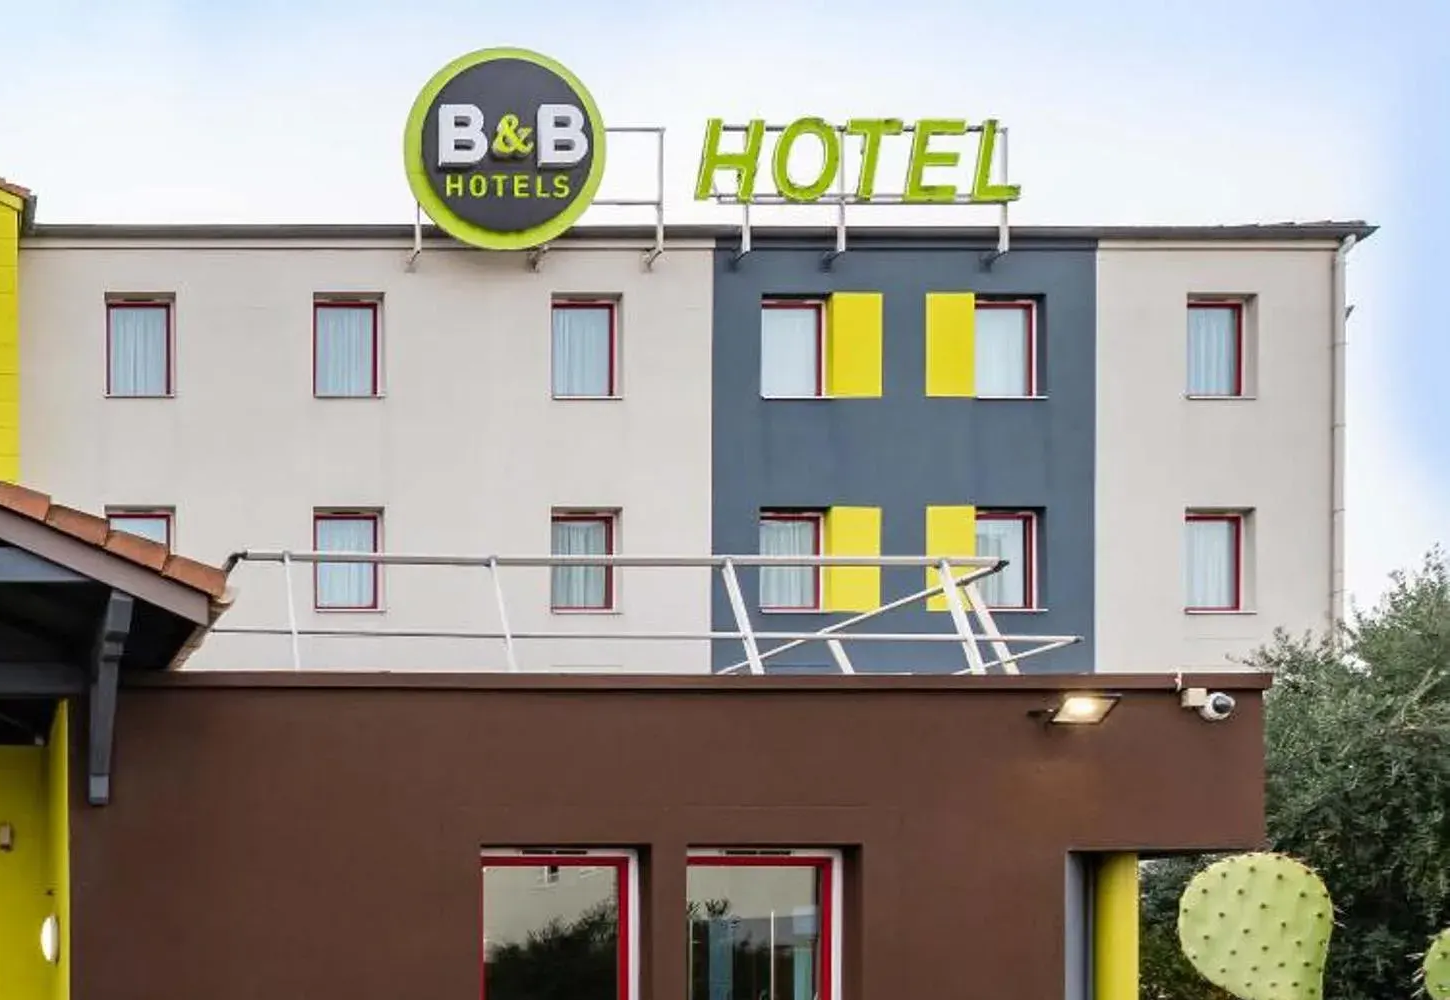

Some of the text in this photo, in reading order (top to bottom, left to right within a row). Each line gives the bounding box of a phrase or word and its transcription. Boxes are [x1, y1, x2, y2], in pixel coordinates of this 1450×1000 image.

[437, 104, 589, 169] B&B
[694, 117, 1022, 203] HOTEL
[445, 173, 571, 200] HOTELS
